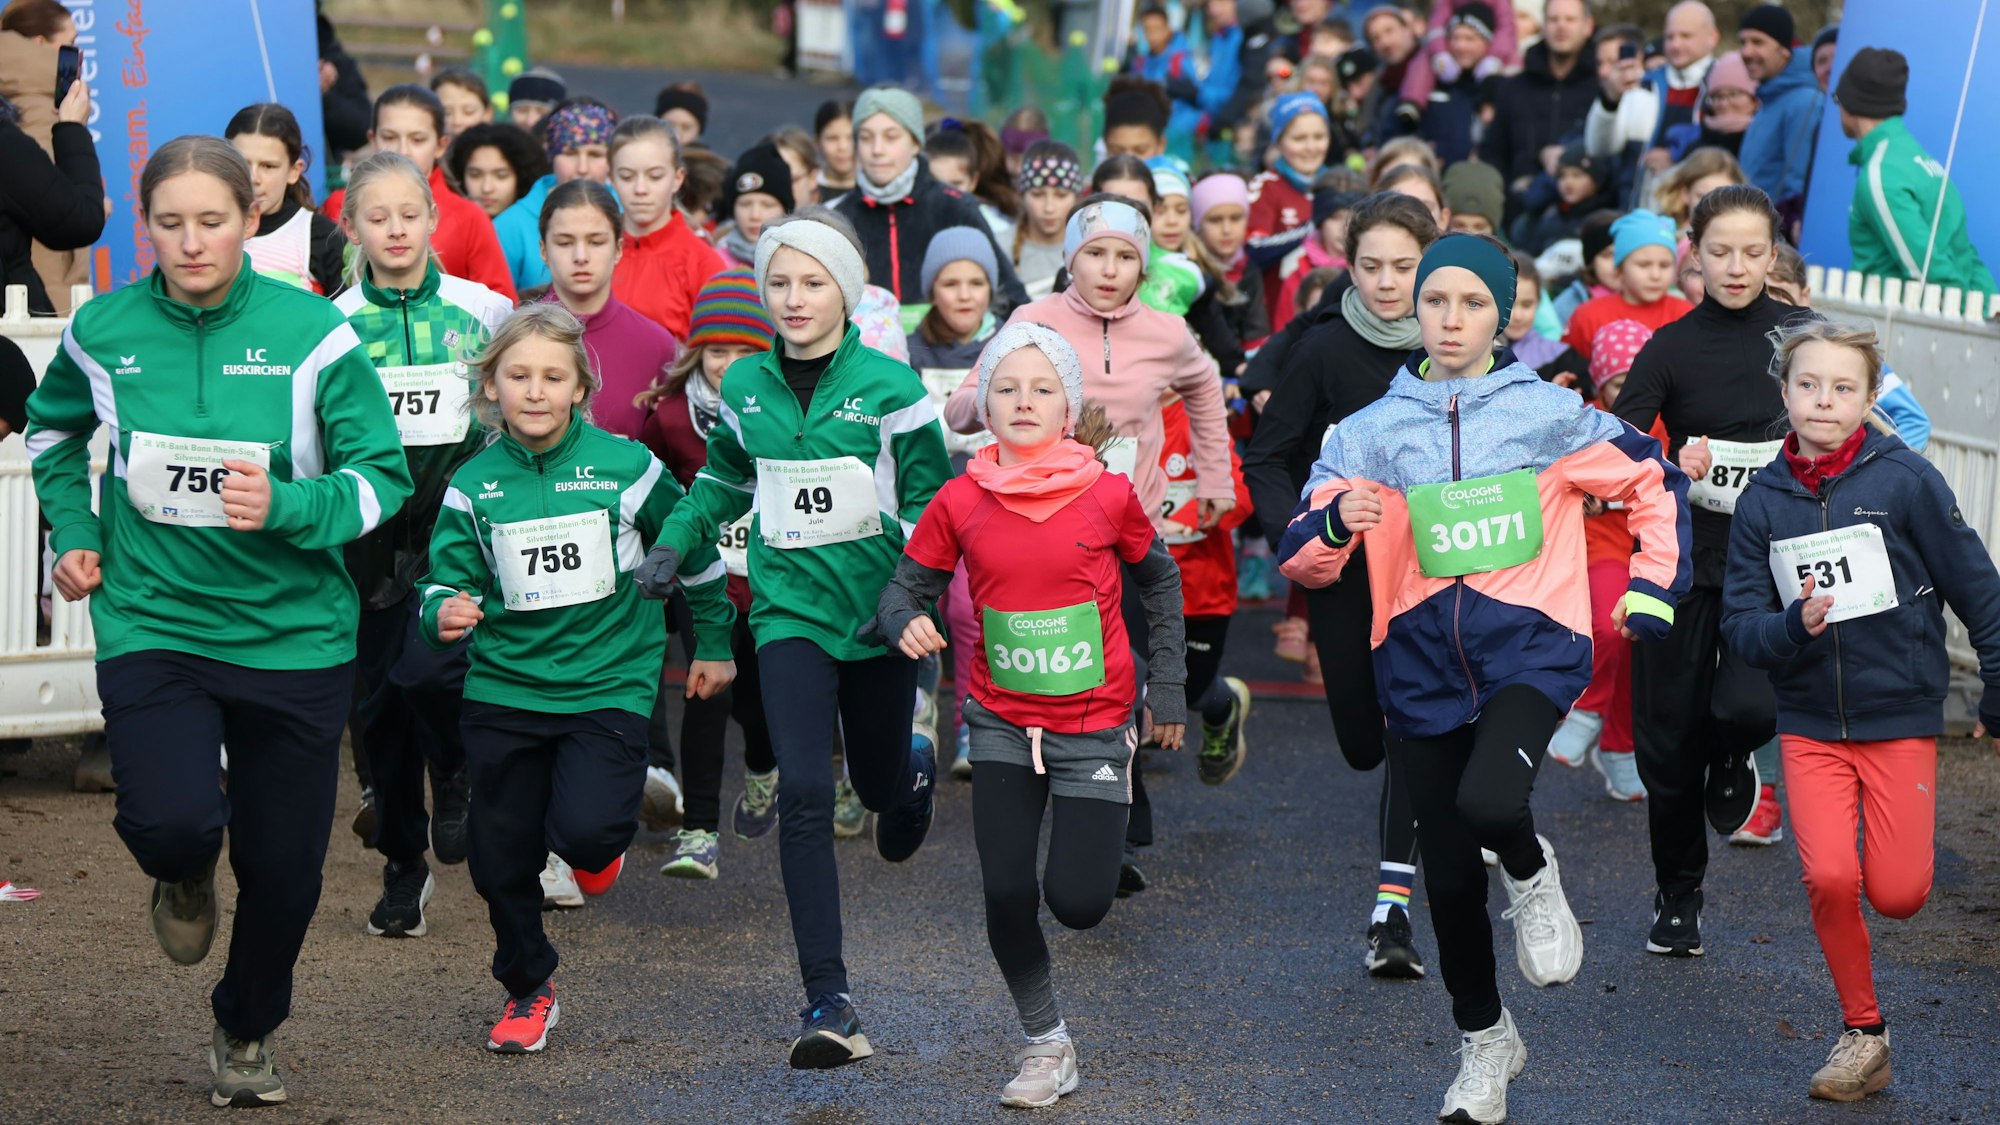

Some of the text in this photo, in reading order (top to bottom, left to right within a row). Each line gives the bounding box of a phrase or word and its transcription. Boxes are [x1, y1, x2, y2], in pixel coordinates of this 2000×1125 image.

[246, 348, 267, 362] LC
[115, 366, 142, 374] erima
[223, 364, 290, 376] EUSKIRCHEN
[394, 380, 434, 388] Silvesterlauf
[388, 390, 440, 416] 757
[844, 398, 863, 410] LC
[156, 440, 188, 451] VR-Bank
[191, 442, 212, 452] Bonn
[213, 445, 256, 457] Rhein-Sieg
[576, 466, 594, 479] LC
[774, 465, 800, 474] VR-Bank
[801, 465, 818, 474] Bonn
[820, 462, 859, 473] Rhein-Sieg
[166, 464, 230, 494] 756
[788, 475, 832, 484] Silvesterlauf
[555, 480, 618, 492] EUSKIRCHEN
[1448, 484, 1502, 500] COLOGNE
[479, 490, 504, 499] erima
[794, 486, 832, 514] 49
[1466, 495, 1504, 507] TIMING
[506, 526, 538, 536] VR-Bank
[540, 522, 557, 530] Bonn
[558, 518, 598, 530] Rhein-Sieg
[1430, 512, 1526, 553] 30171
[526, 532, 570, 544] Silvesterlauf
[1779, 543, 1808, 554] VR-Bank
[1810, 537, 1829, 548] Bonn
[1830, 530, 1870, 543] Rhein-Sieg
[520, 542, 582, 576] 758
[1798, 546, 1843, 560] Silvesterlauf
[1796, 556, 1852, 589] 531
[1014, 616, 1067, 629] COLOGNE
[1032, 626, 1068, 636] TIMING
[994, 641, 1093, 674] 30162
